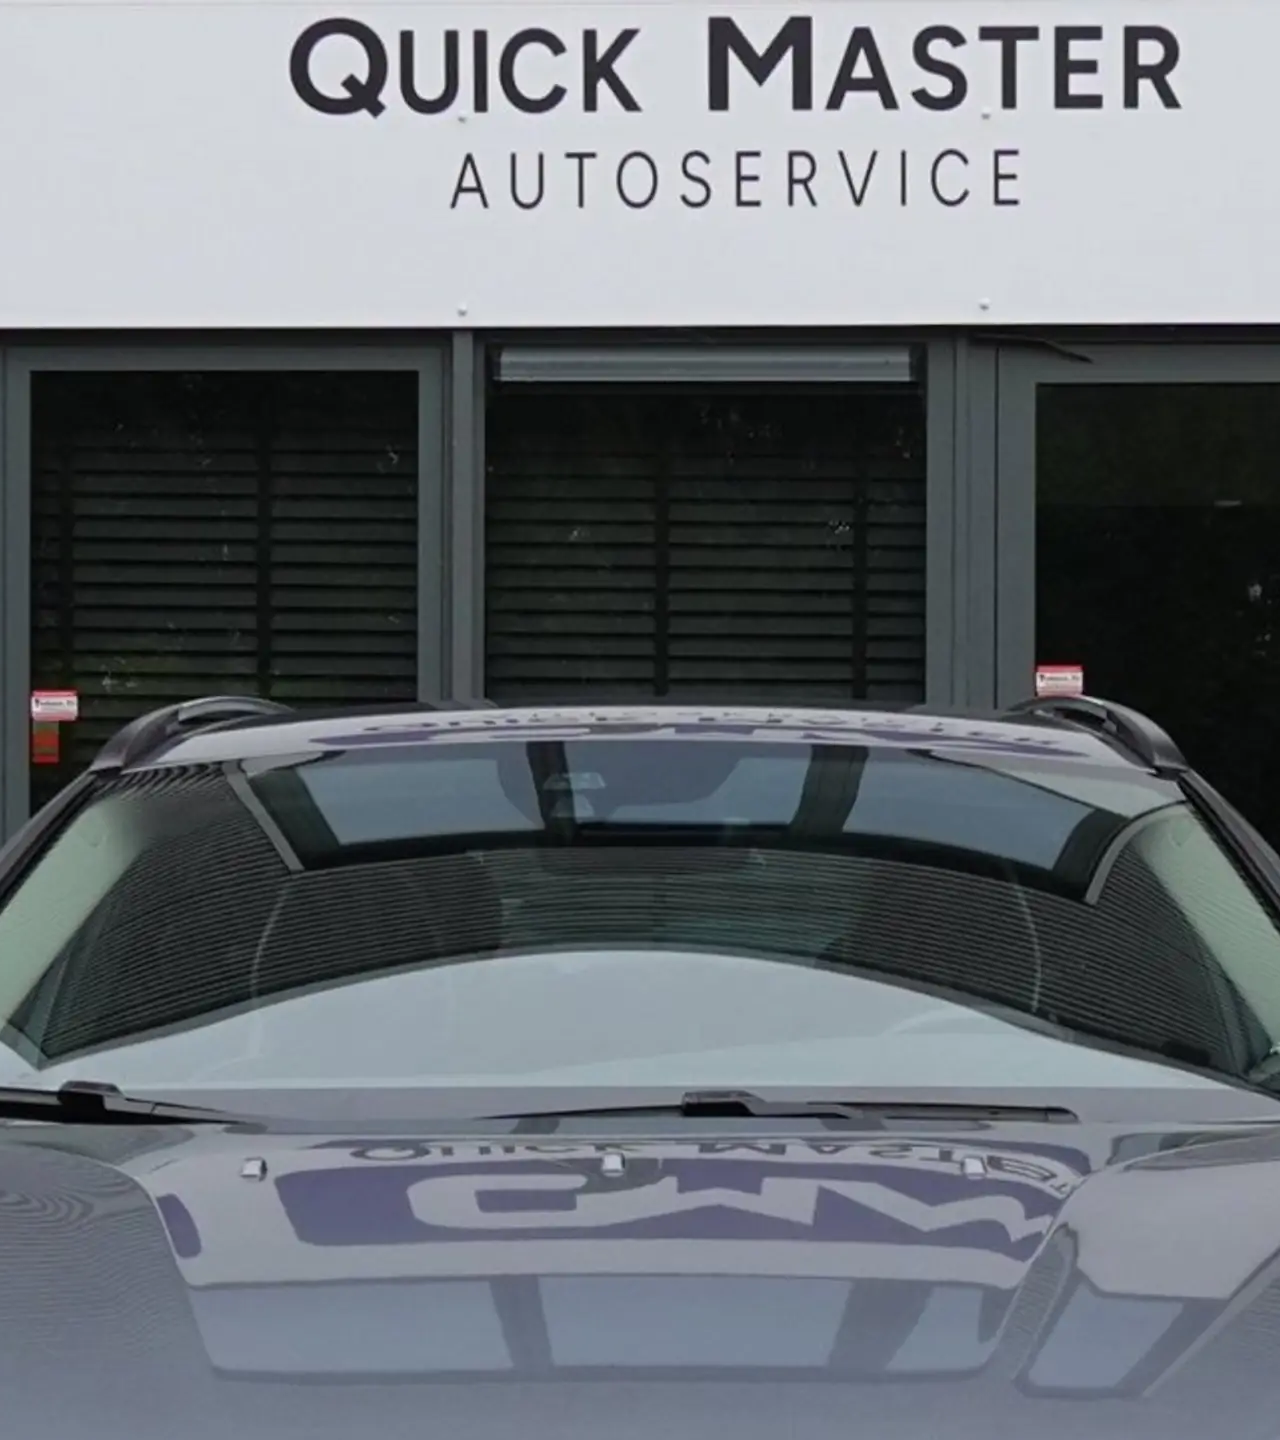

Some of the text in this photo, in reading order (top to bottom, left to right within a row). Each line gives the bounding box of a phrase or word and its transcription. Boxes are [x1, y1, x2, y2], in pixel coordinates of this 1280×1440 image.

[289, 16, 1182, 118] QUICK MASTER
[450, 149, 1020, 209] AUTOSERVICE
